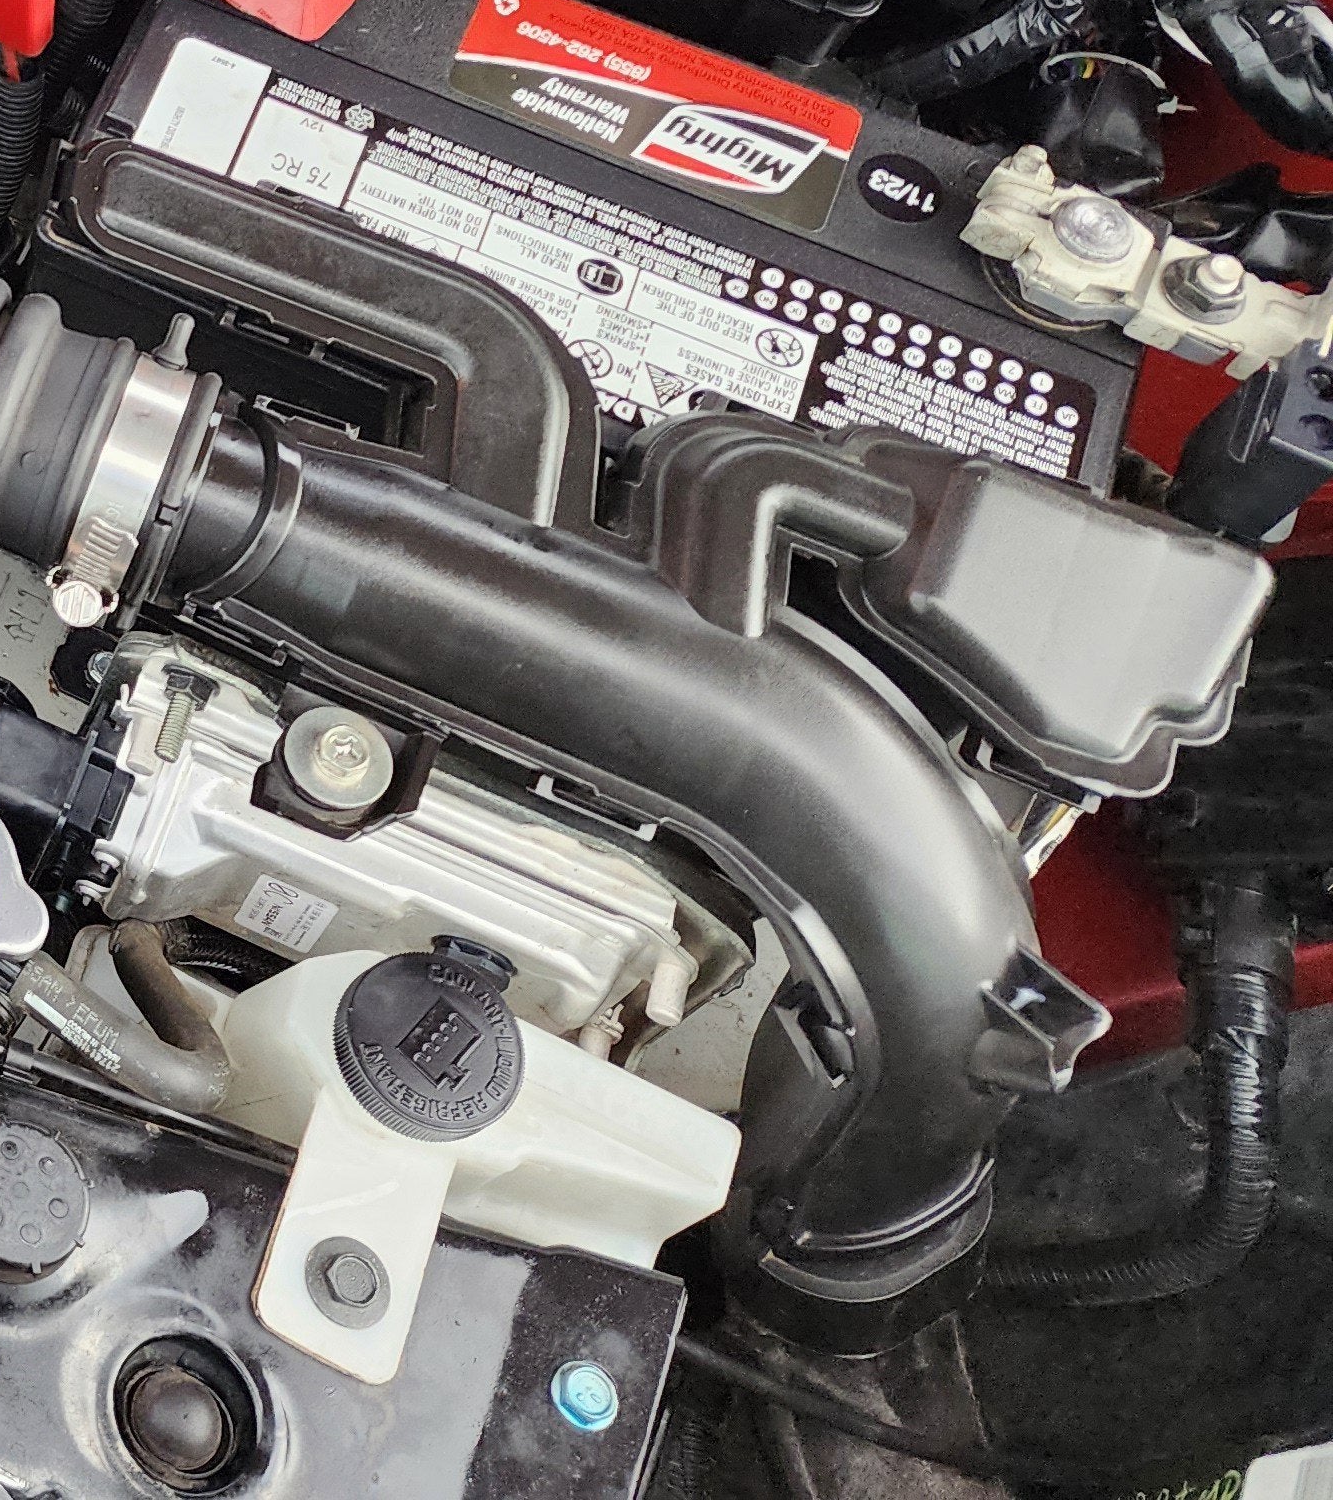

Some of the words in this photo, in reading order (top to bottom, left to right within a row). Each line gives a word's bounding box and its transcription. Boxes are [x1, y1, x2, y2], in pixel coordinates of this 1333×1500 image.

[515, 20, 603, 64] 262-4506
[602, 50, 652, 83] (855)
[268, 83, 298, 103] MUST
[537, 75, 629, 125] Warranty
[295, 93, 341, 120] BATTERY
[509, 85, 623, 144] Nationwide
[299, 115, 326, 133] 12V
[662, 116, 794, 182] Mighty
[269, 150, 303, 178] RC
[305, 164, 333, 189] 75
[357, 181, 407, 209] BATTERY.
[415, 191, 437, 208] TIP.
[865, 166, 936, 214] 11/23
[407, 200, 438, 220] OPEN
[438, 212, 461, 229] NOT
[441, 203, 465, 219] NOT
[465, 212, 483, 227] DO
[461, 222, 479, 236] DO
[490, 222, 574, 262] INSTRUCTIONS.
[517, 244, 538, 260] ALL
[538, 252, 570, 272] READ
[478, 263, 517, 286] BURNS.
[515, 278, 556, 301] SEVERE
[637, 280, 697, 311] CHILDREN.
[545, 302, 569, 320] CAN
[555, 293, 572, 308] OR
[654, 297, 675, 314] THE
[698, 303, 716, 318] OF
[674, 306, 694, 321] OF
[693, 313, 720, 332] OUT
[717, 311, 755, 334] REACH
[719, 324, 751, 344] KEEP
[615, 362, 633, 377] NO
[675, 345, 736, 377] BLINDNESS
[739, 358, 781, 382] INJURY.
[683, 363, 723, 387] GASES
[735, 369, 772, 391] CAUSE
[780, 375, 799, 389] OR
[724, 379, 792, 414] EXPLOSIVE
[771, 383, 796, 401] CAN
